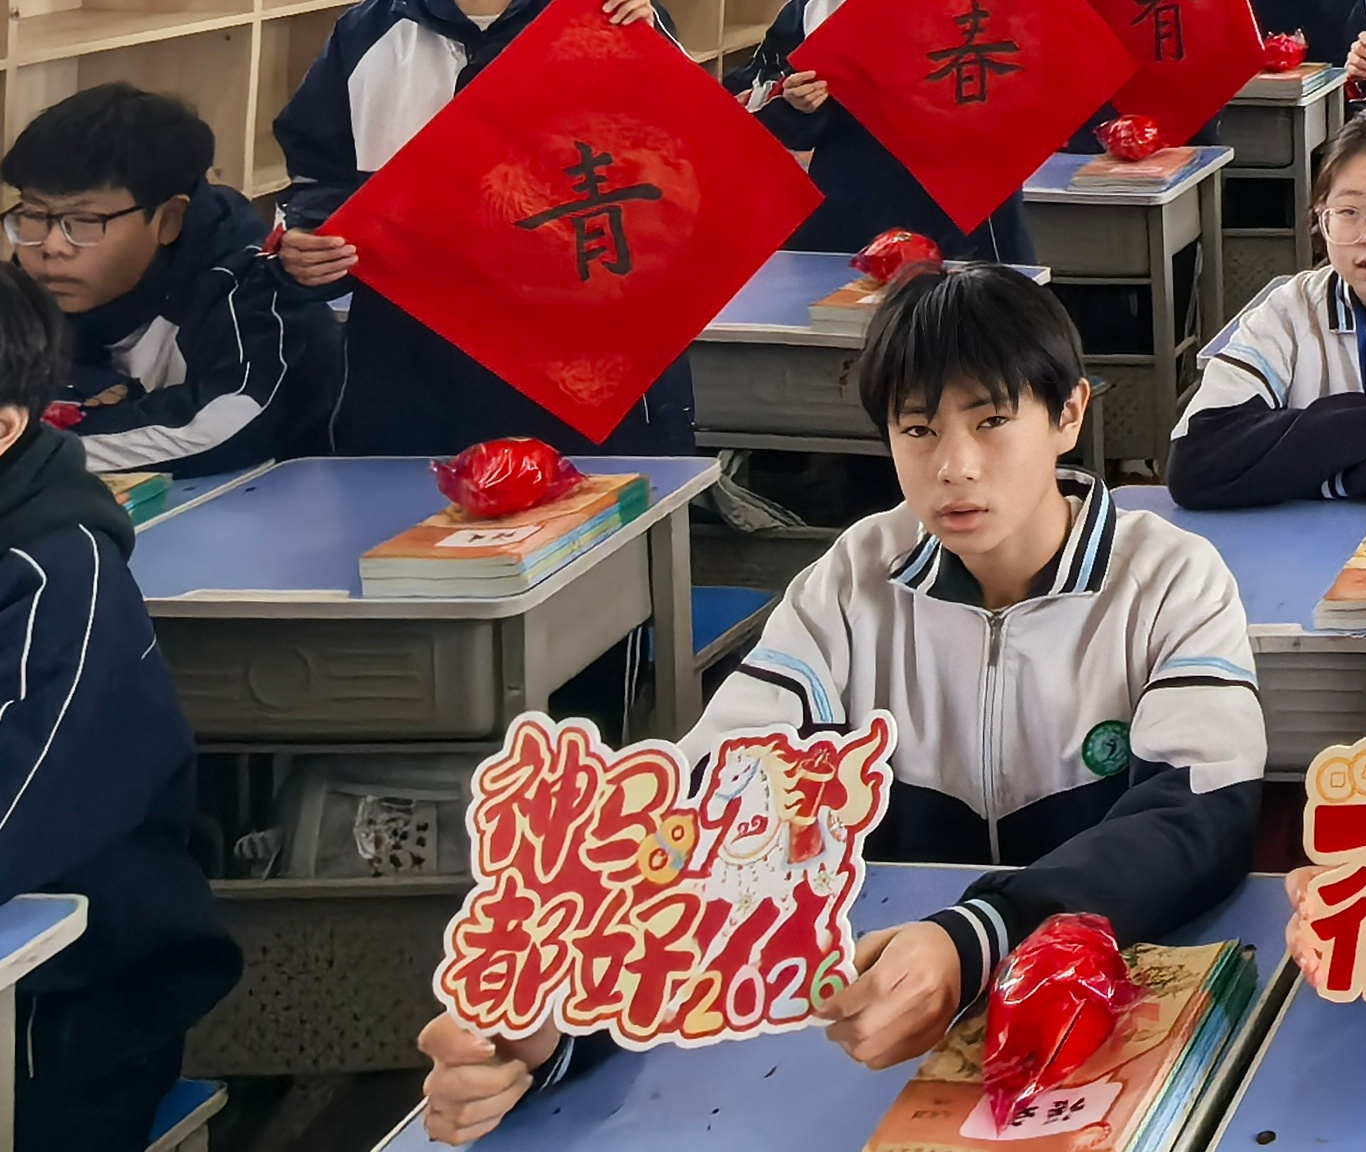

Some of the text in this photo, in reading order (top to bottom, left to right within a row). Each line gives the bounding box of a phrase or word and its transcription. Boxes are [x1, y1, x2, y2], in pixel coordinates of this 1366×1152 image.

[512, 141, 662, 282] 青
[482, 726, 678, 884] 神马
[452, 873, 700, 1035] 都好
[683, 950, 846, 1035] 2026
